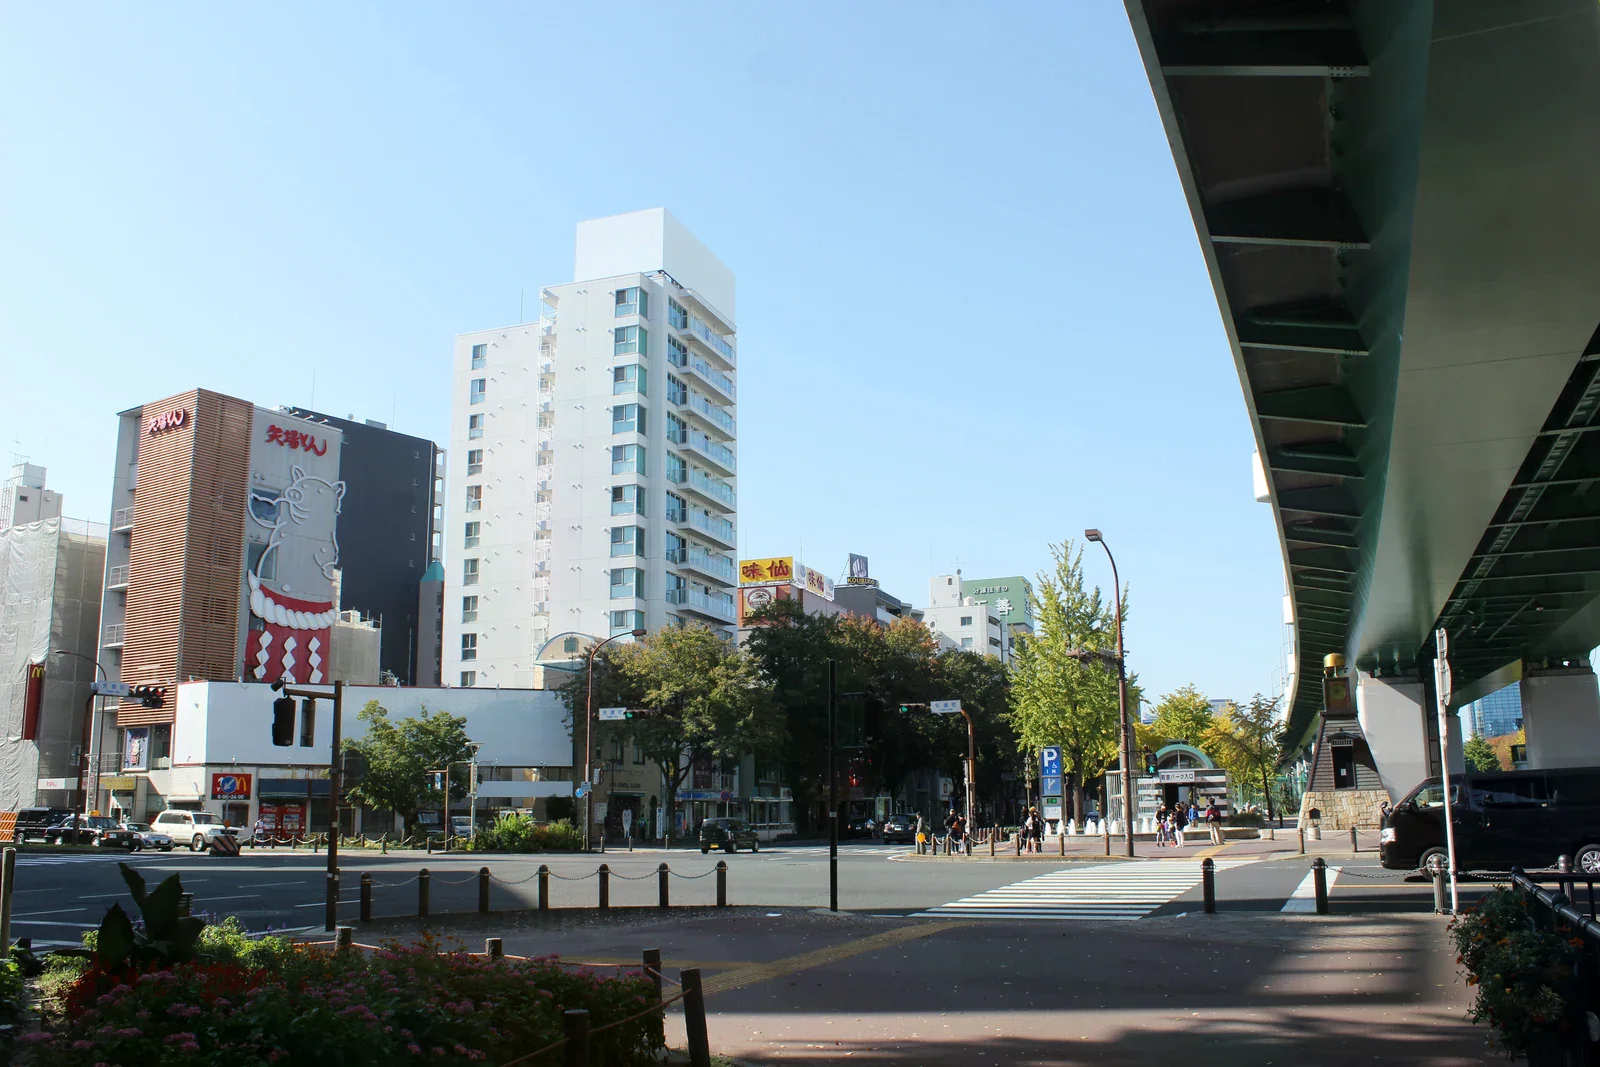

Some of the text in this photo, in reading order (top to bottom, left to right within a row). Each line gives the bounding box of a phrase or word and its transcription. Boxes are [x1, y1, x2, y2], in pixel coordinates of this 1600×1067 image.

[147, 409, 185, 433] 矢場とん
[265, 424, 328, 457] 矢場とん
[742, 559, 790, 579] 味仙
[808, 570, 824, 592] 味仙
[974, 597, 1015, 617] 善
[1042, 748, 1058, 768] P
[1161, 773, 1194, 781] 若宮パーク入口
